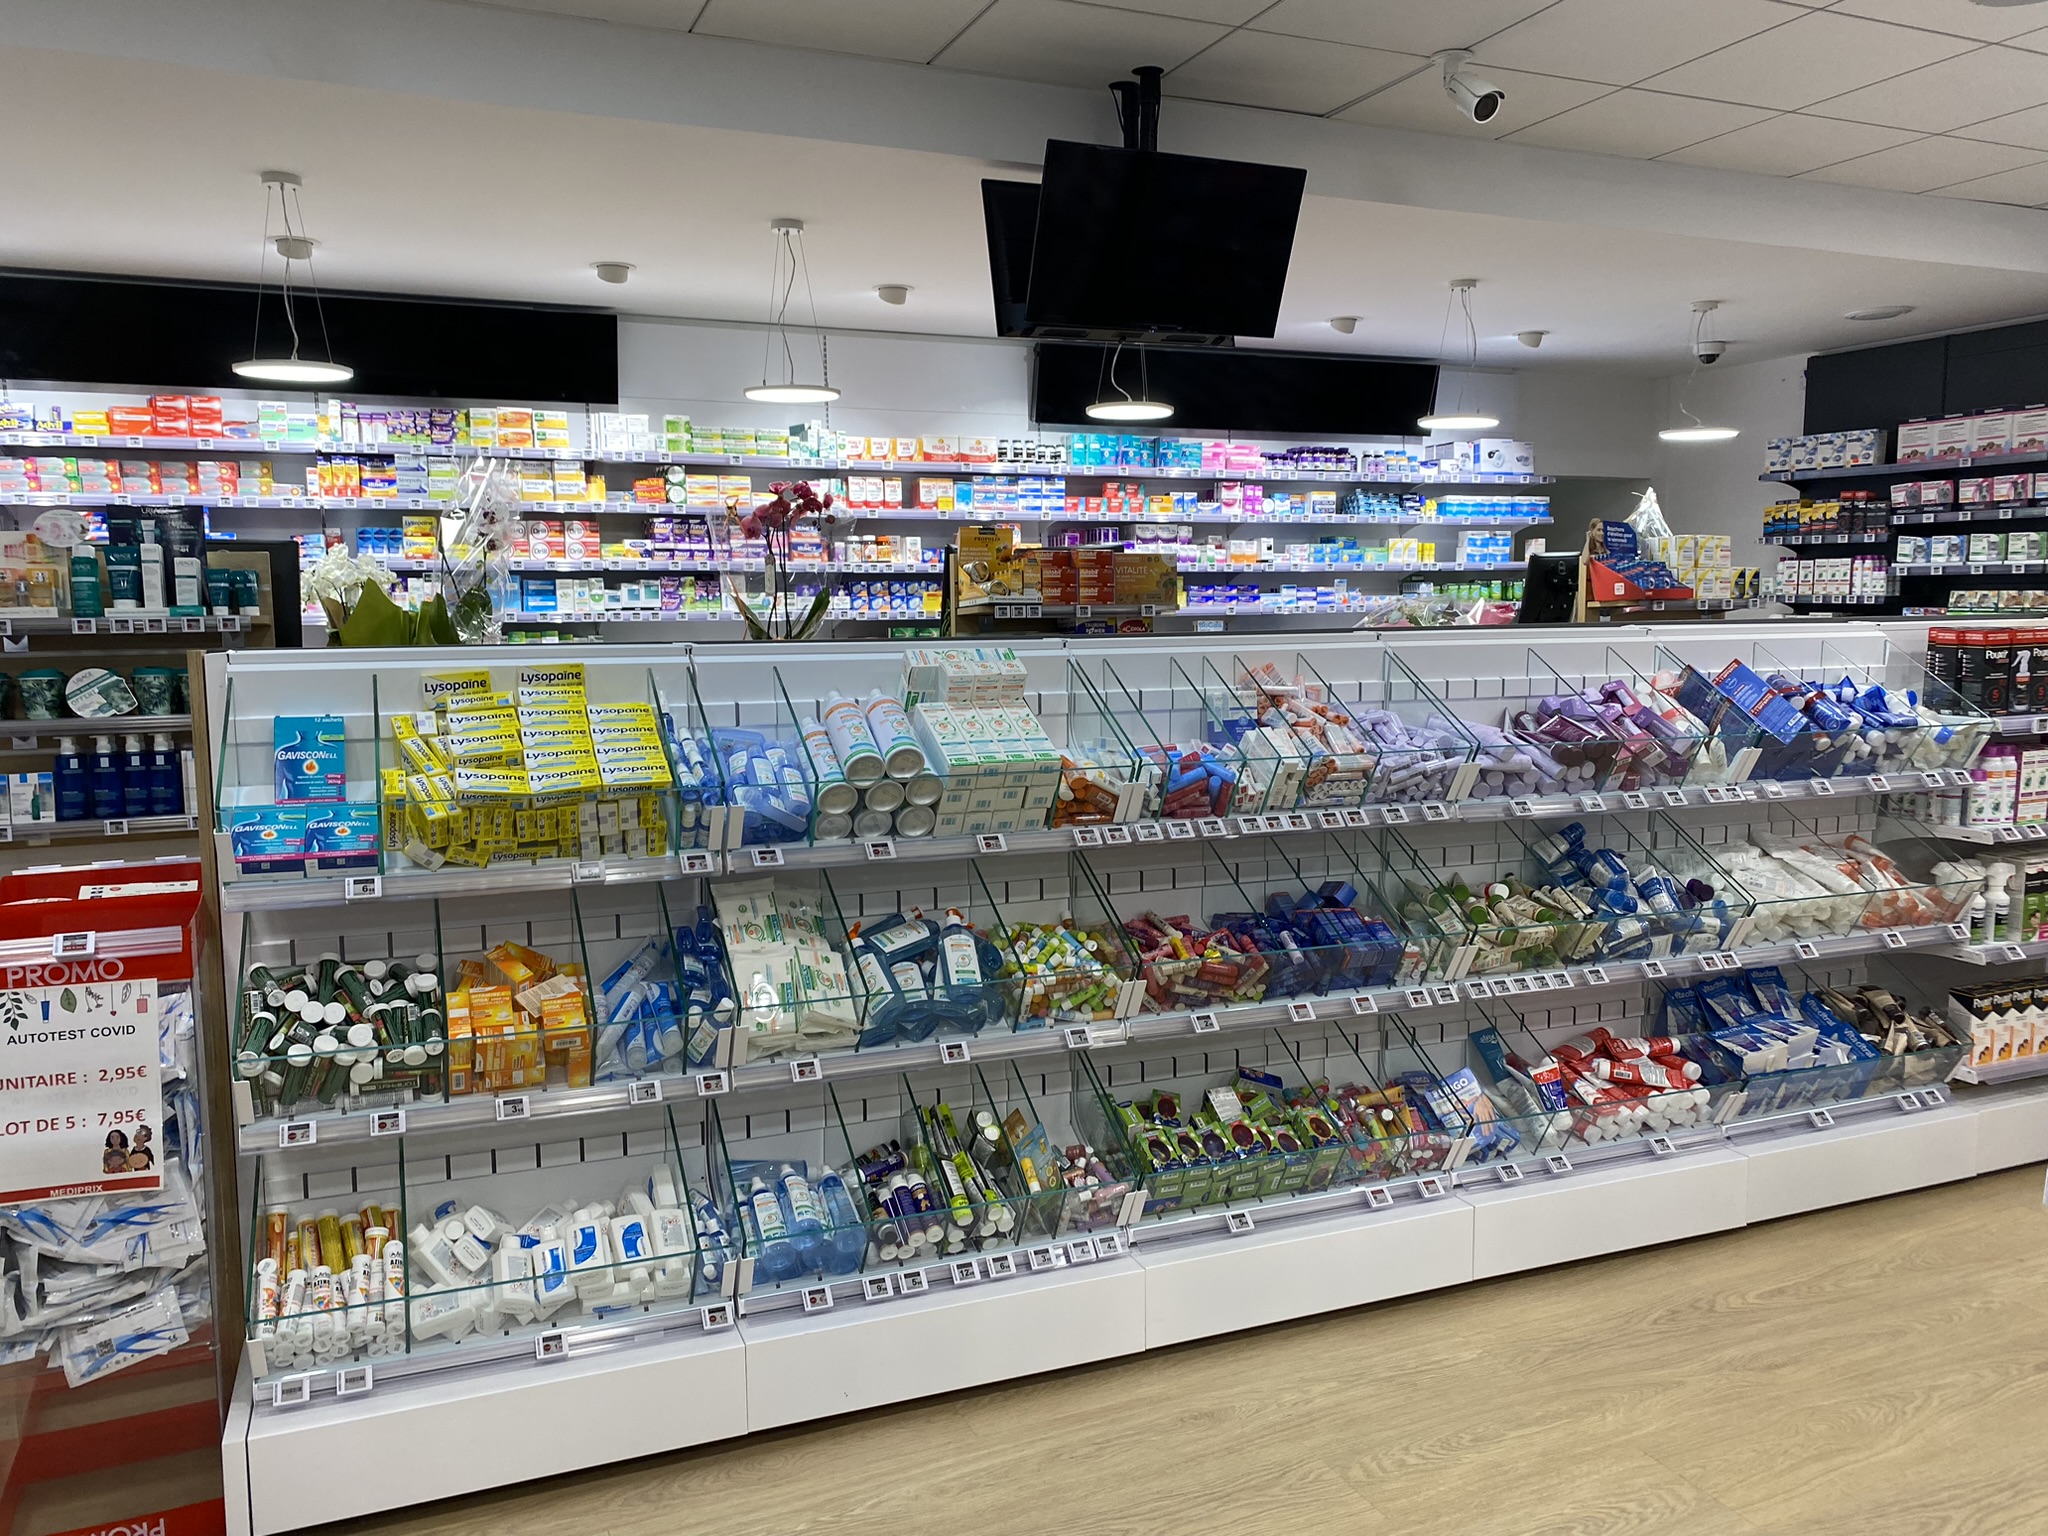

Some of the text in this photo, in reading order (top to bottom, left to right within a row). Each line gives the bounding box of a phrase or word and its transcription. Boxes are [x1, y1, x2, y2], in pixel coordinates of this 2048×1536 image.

[521, 669, 582, 685] Lysopaïne
[424, 677, 487, 695] Lysopaïne
[521, 688, 582, 697] Lysopaïne
[450, 695, 494, 706] Lysopaïne
[450, 711, 513, 725] Lysopaïne
[520, 708, 583, 718] Lysopaïne
[589, 707, 650, 716] Lysopaïne
[523, 727, 587, 739] Lysopaïne
[592, 726, 654, 736] Lysopaïne
[450, 732, 515, 746] Lysopaïne
[526, 748, 590, 761] Lysopaïne
[597, 744, 660, 755] Lysopaïne
[530, 767, 596, 783] Lysopaïne
[602, 764, 666, 775] Lysopaïne
[457, 771, 525, 782] Lysopaïne
[6, 957, 125, 988] PROMO
[7, 1024, 136, 1046] AUTOTEST COVID
[98, 1065, 147, 1083] 2,95€
[36, 1117, 60, 1132] DE
[65, 1115, 76, 1130] 5
[97, 1108, 146, 1128] 7,95€
[50, 1183, 104, 1198] MEDIPRIX
